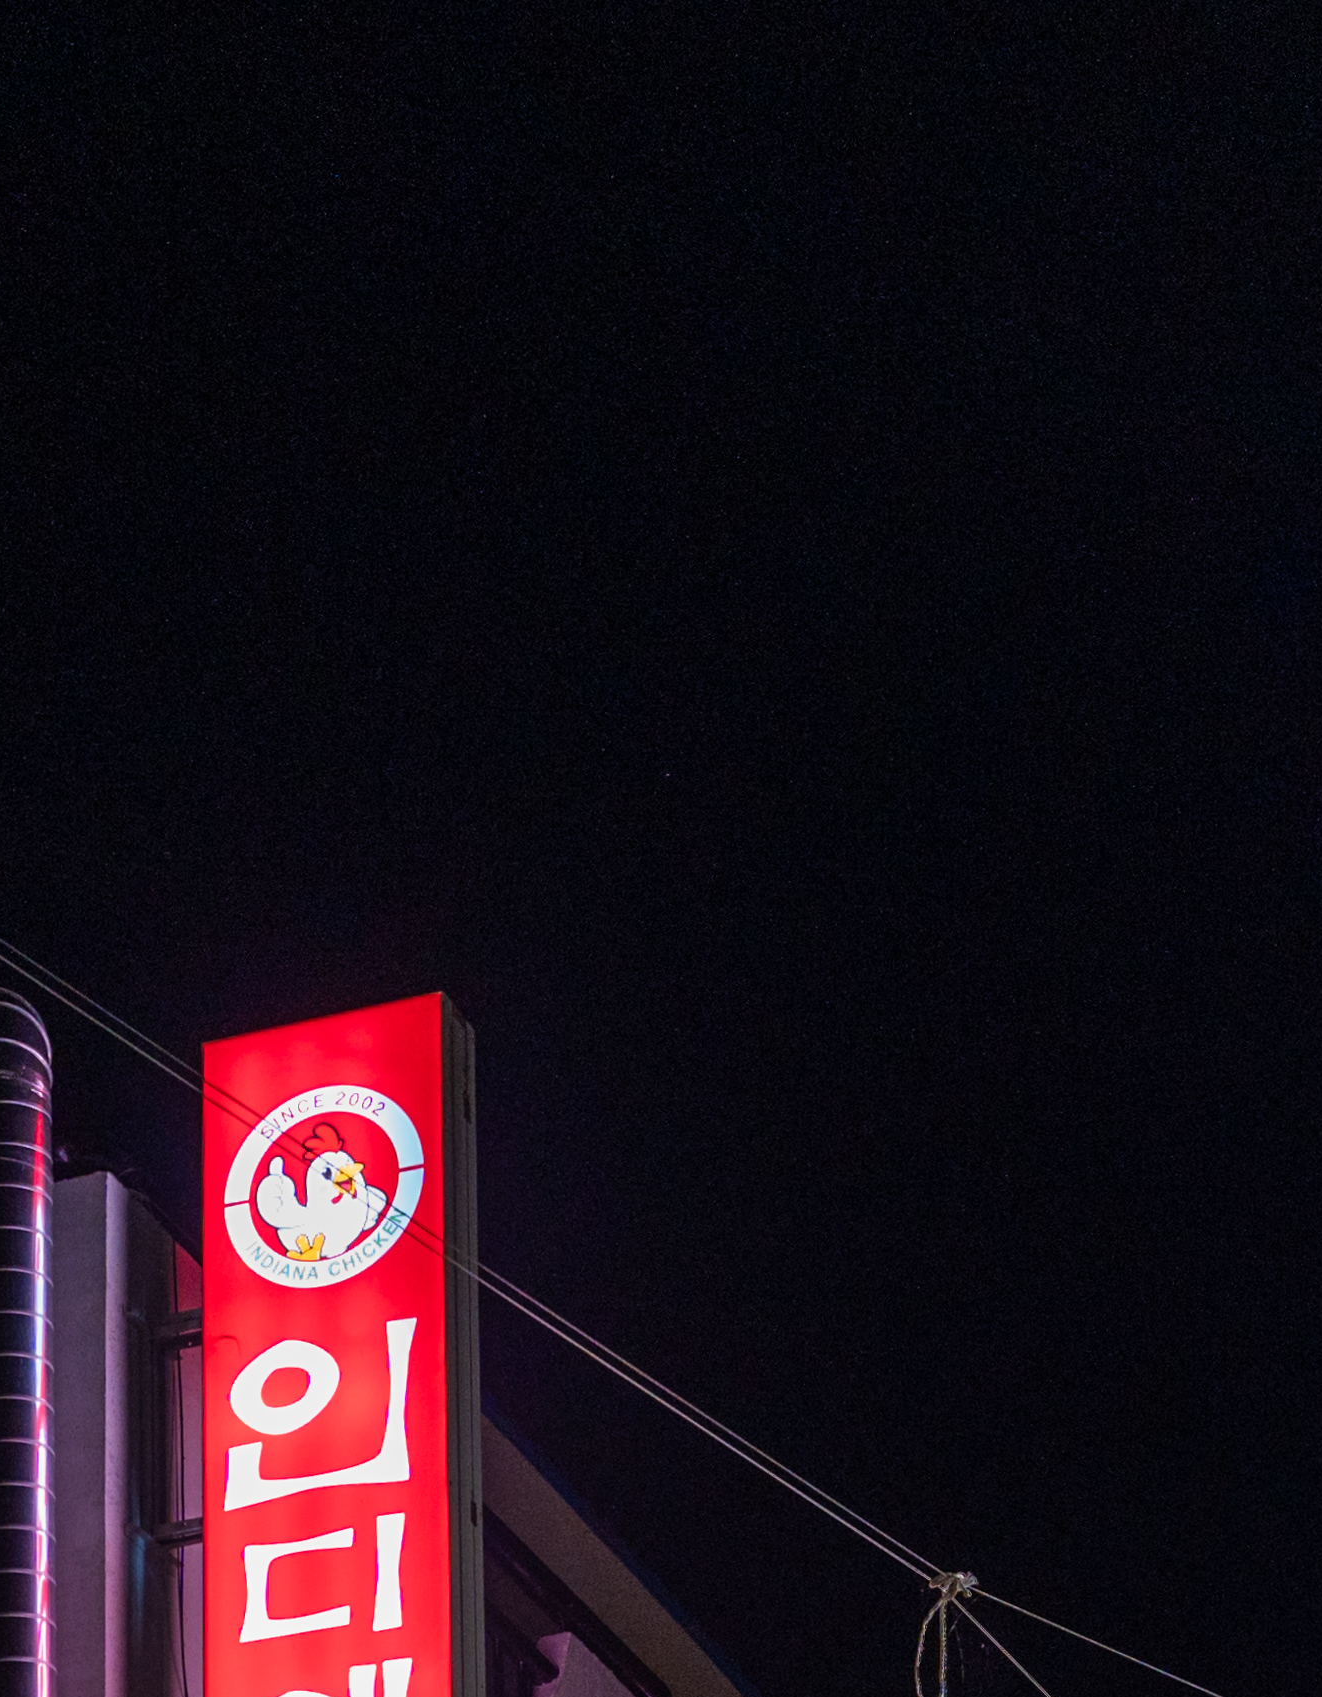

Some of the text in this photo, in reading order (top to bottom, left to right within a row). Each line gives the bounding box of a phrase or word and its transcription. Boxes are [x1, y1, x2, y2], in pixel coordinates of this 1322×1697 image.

[261, 1092, 385, 1138] SINCE 2002
[247, 1208, 406, 1280] INDIANA CHICKEN
